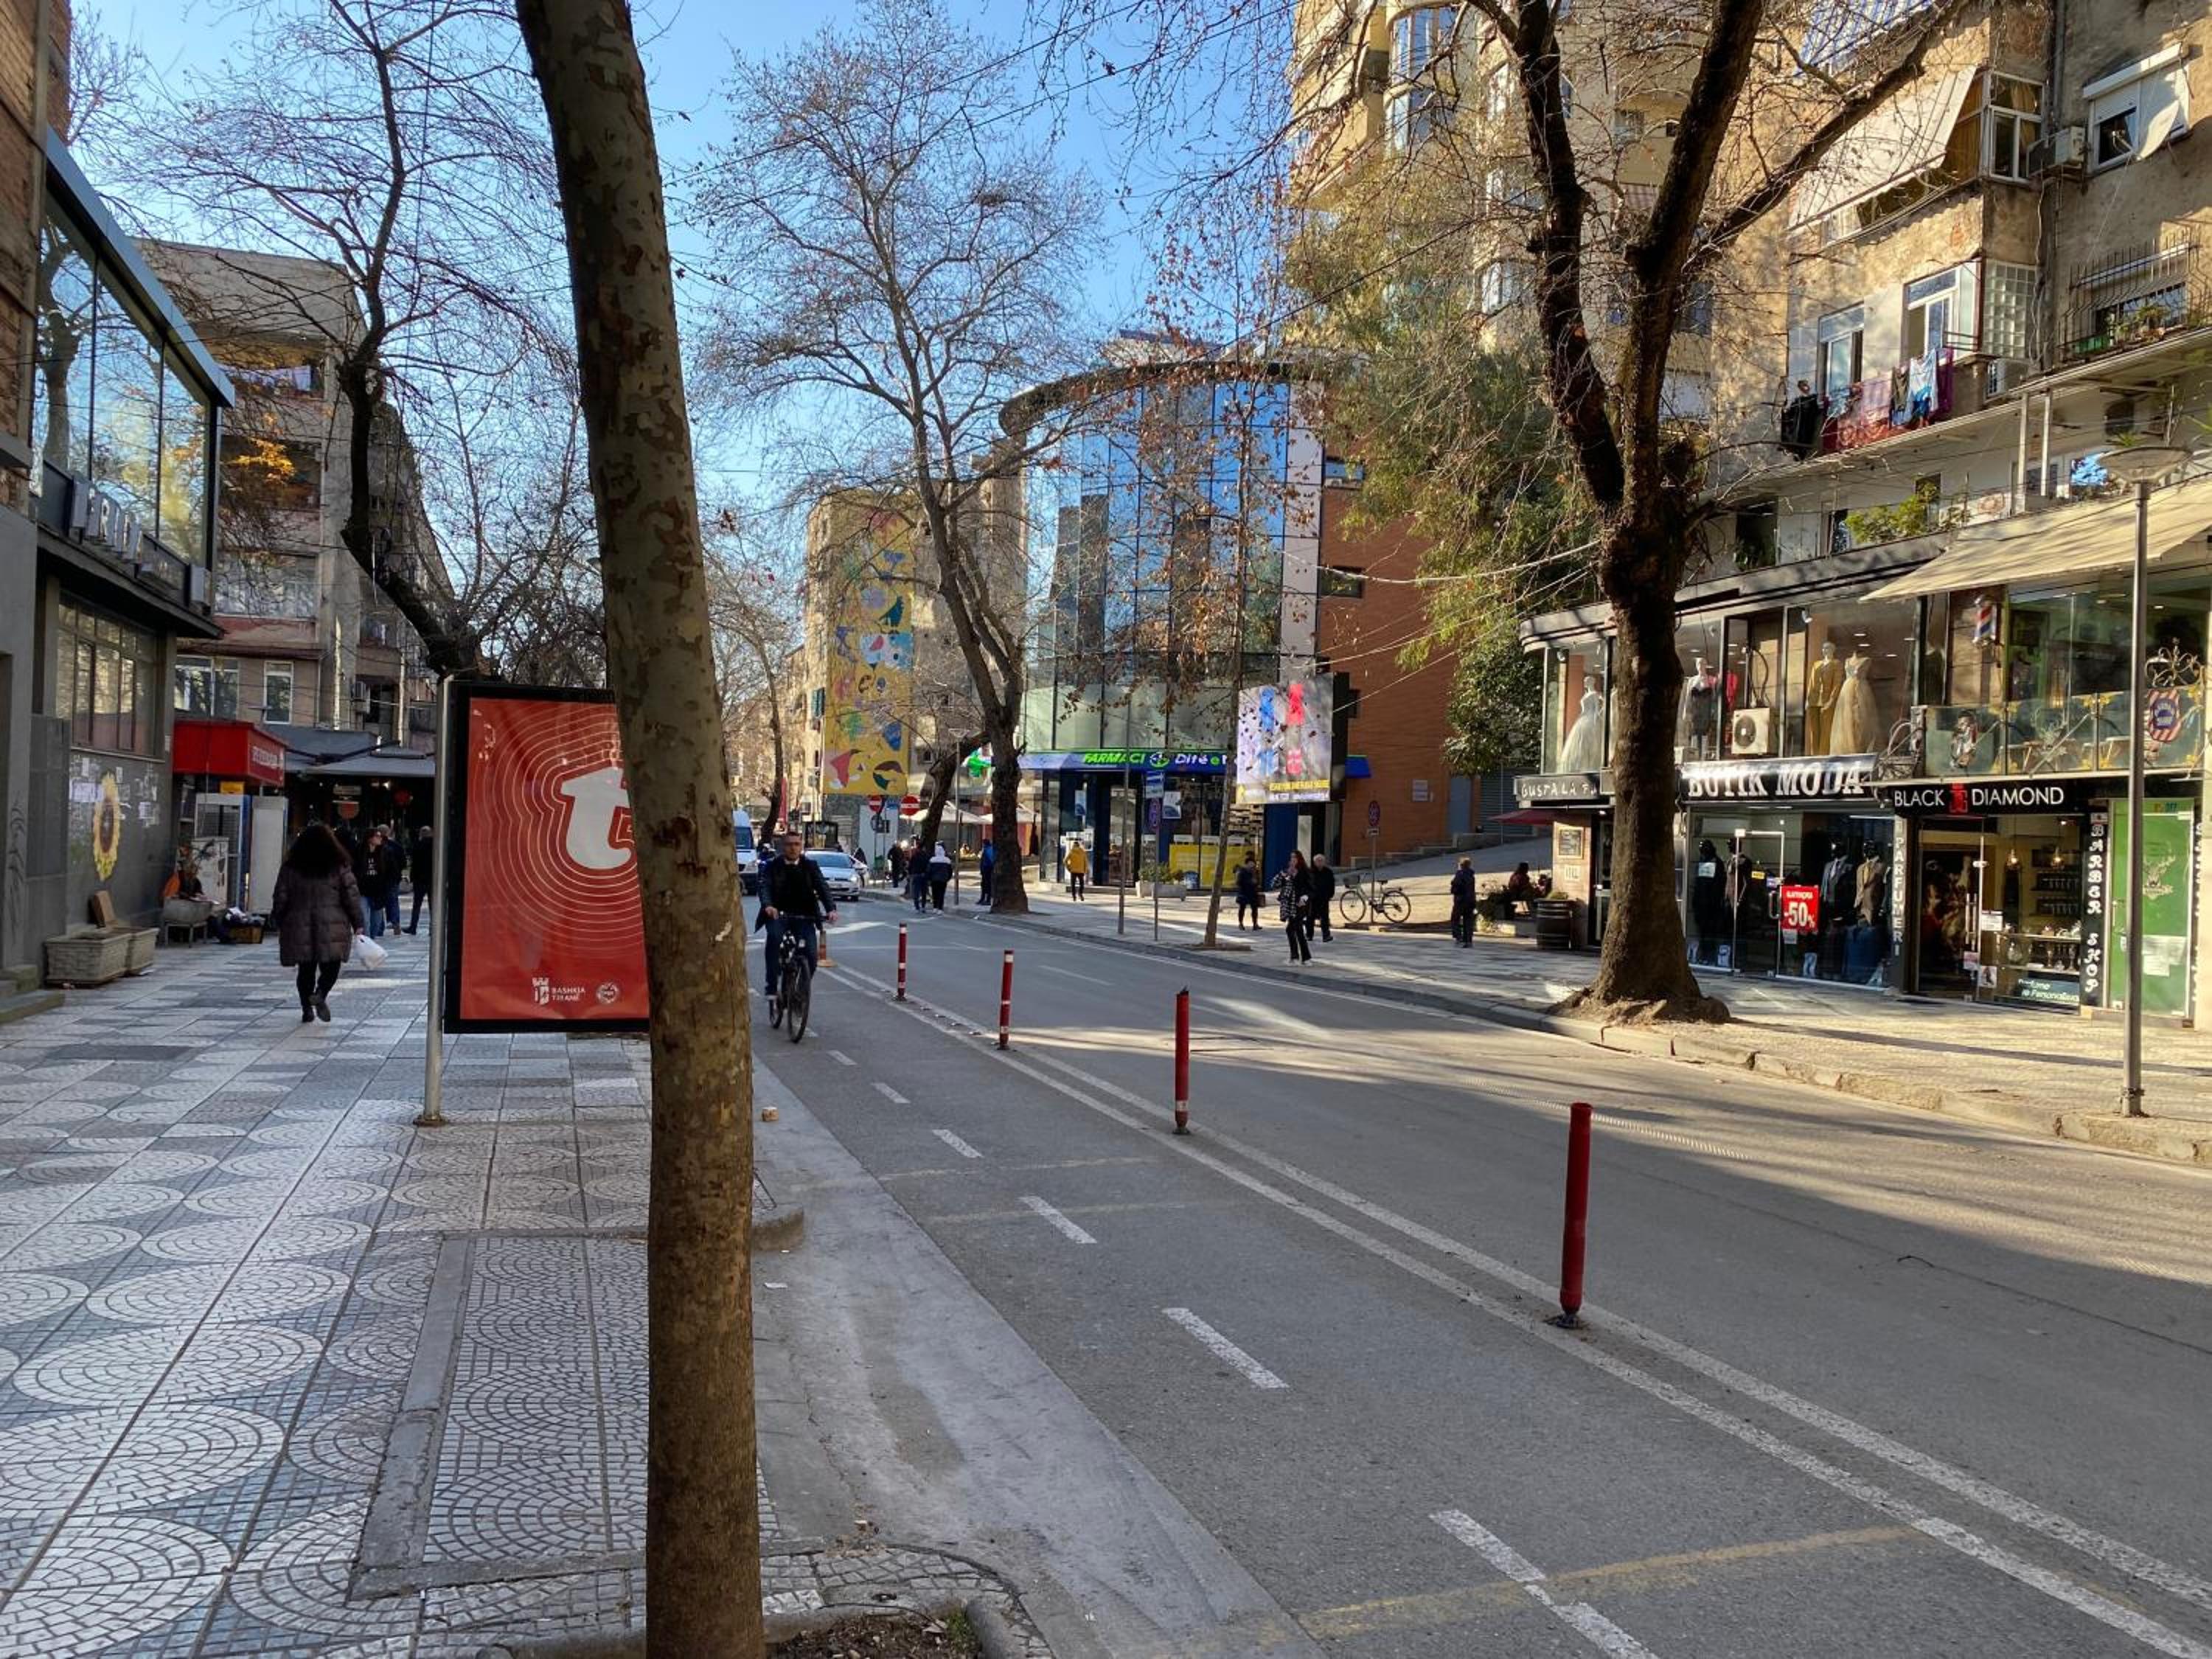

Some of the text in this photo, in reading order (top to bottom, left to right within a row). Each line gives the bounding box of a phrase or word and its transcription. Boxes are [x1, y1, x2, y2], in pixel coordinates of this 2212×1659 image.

[1082, 752, 1145, 765] FARMACI
[1688, 761, 1865, 797] BUTIK MODA
[1893, 786, 2065, 807] BLACK DIAMOND
[2087, 824, 2105, 915] BARBER
[1783, 901, 1817, 928] -50%
[2084, 932, 2101, 993] SHOP
